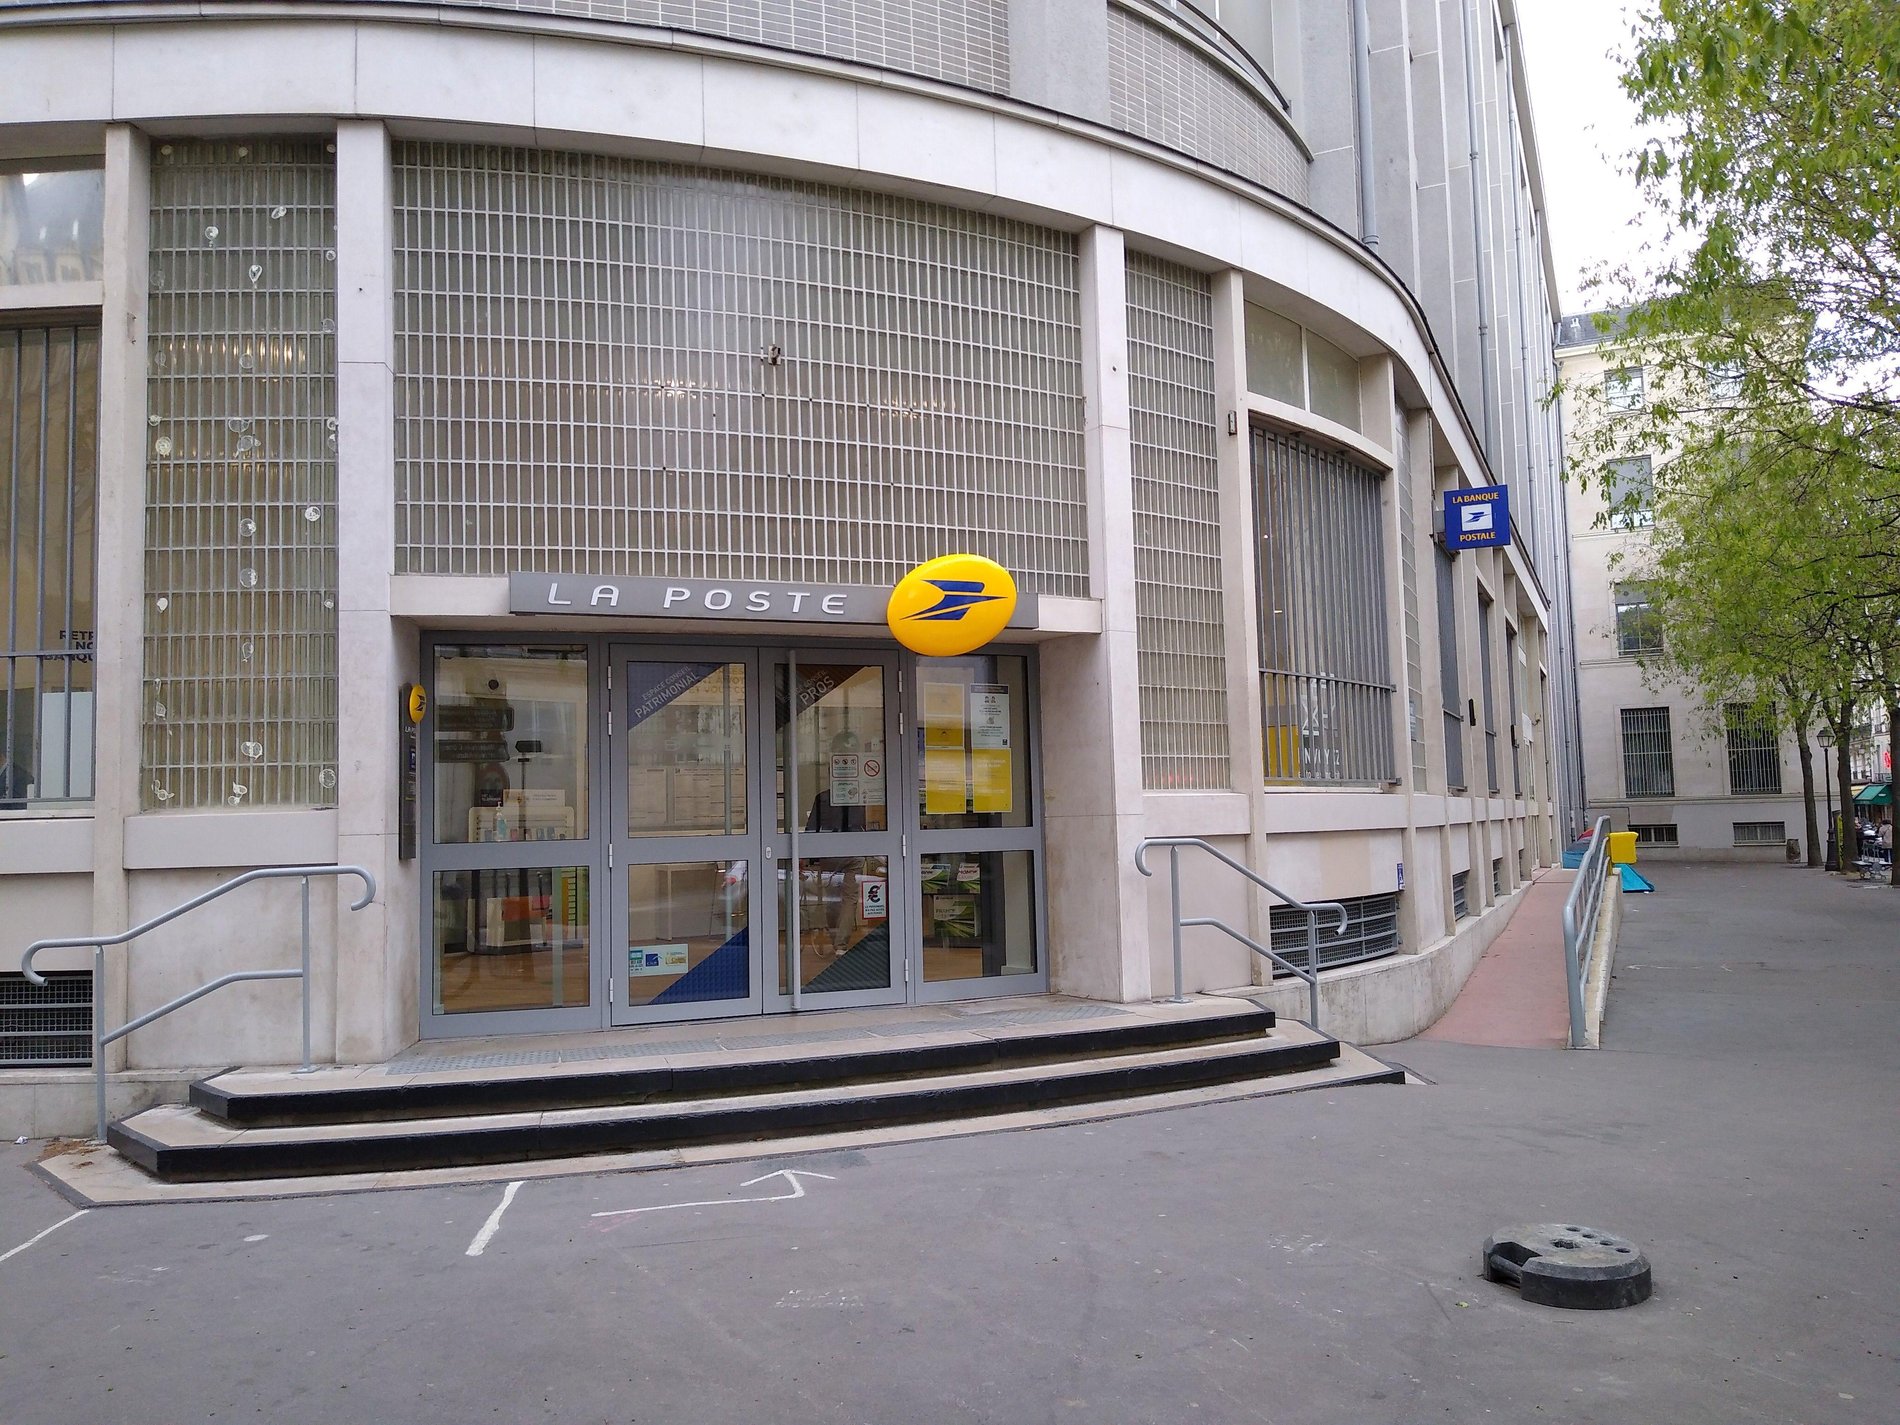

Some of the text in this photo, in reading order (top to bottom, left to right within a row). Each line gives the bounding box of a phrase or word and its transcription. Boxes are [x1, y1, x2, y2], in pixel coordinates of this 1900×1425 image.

[1452, 492, 1500, 504] LA BANQUE
[1460, 532, 1496, 542] POSTALE
[548, 582, 848, 615] LA POSTE
[634, 671, 701, 718] PATRIMONIAL
[641, 680, 666, 701] ESPACE
[799, 675, 835, 705] PROS
